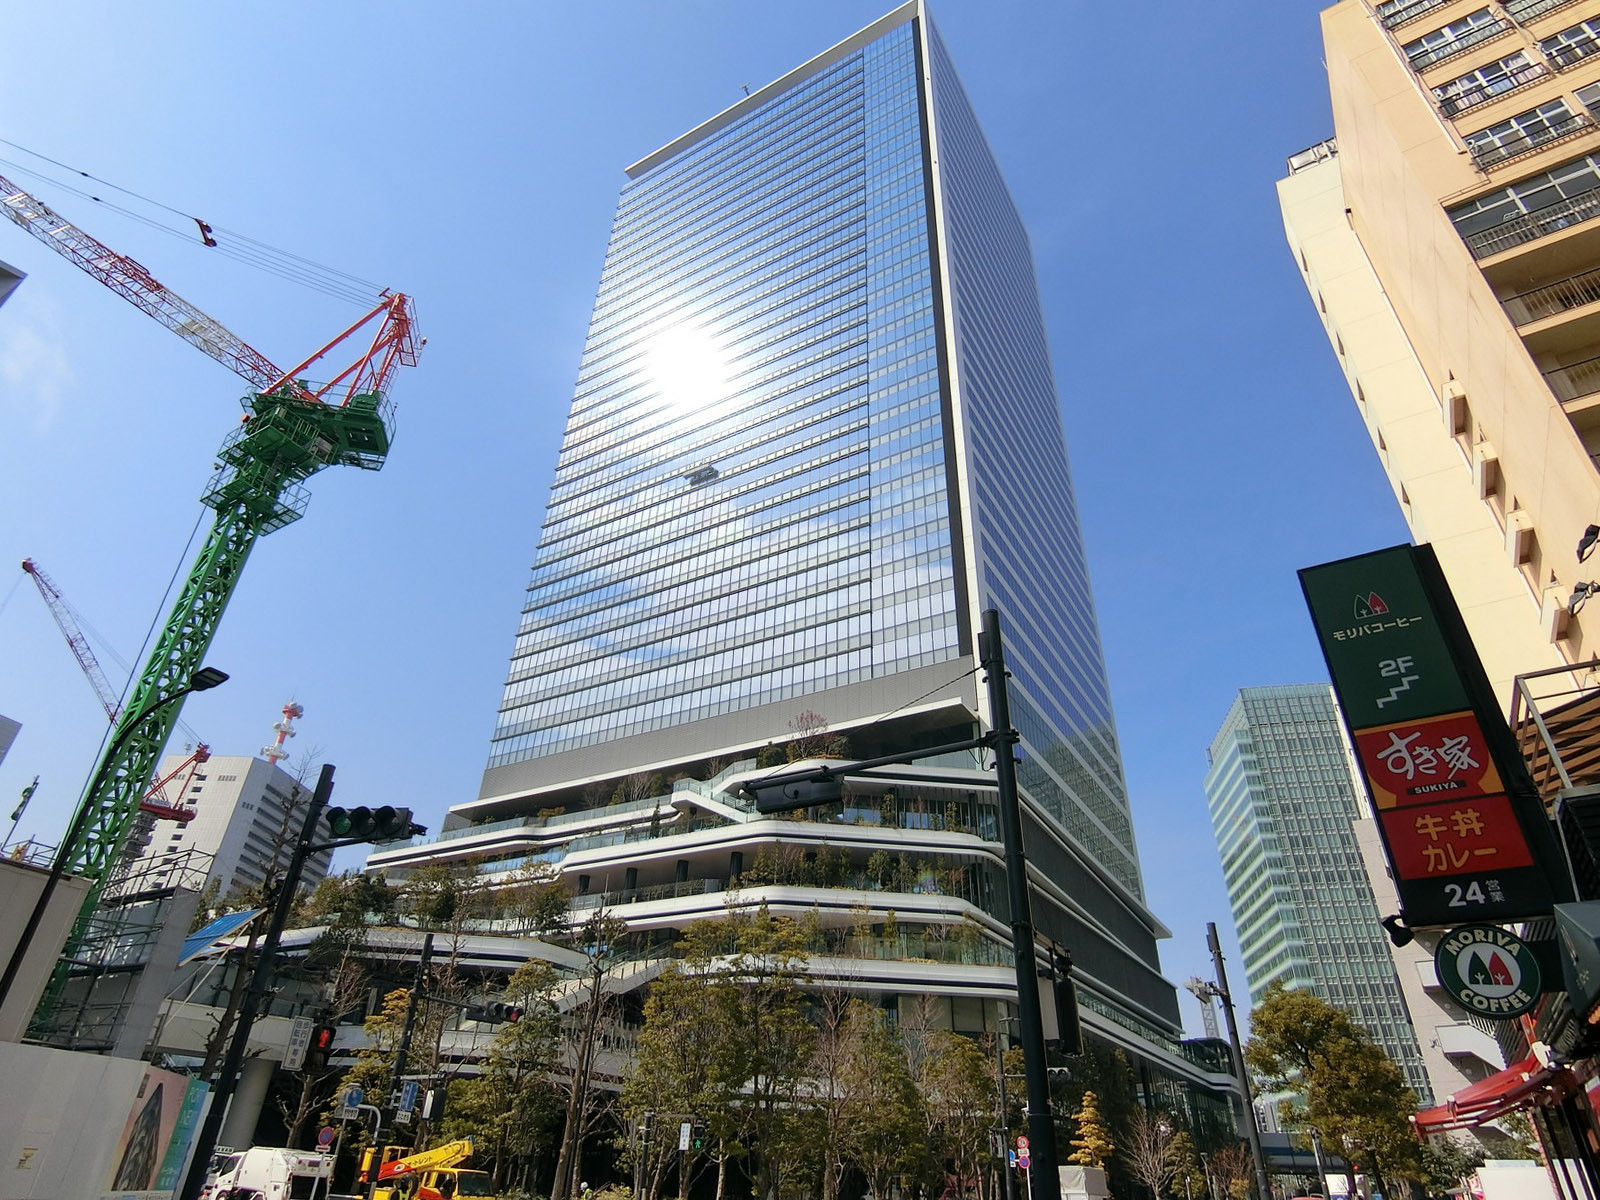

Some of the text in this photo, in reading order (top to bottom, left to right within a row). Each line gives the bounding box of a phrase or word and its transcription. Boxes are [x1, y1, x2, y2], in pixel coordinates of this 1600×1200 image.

[1333, 616, 1422, 641] モリバコーヒー
[1378, 655, 1415, 677] 2F
[1376, 731, 1480, 780] すき家
[1414, 782, 1458, 794] SUKIYA
[1415, 809, 1484, 840] 牛丼
[1422, 844, 1497, 872] カレー
[1445, 929, 1521, 957] MORIVA
[1459, 989, 1531, 1012] COFFEE
